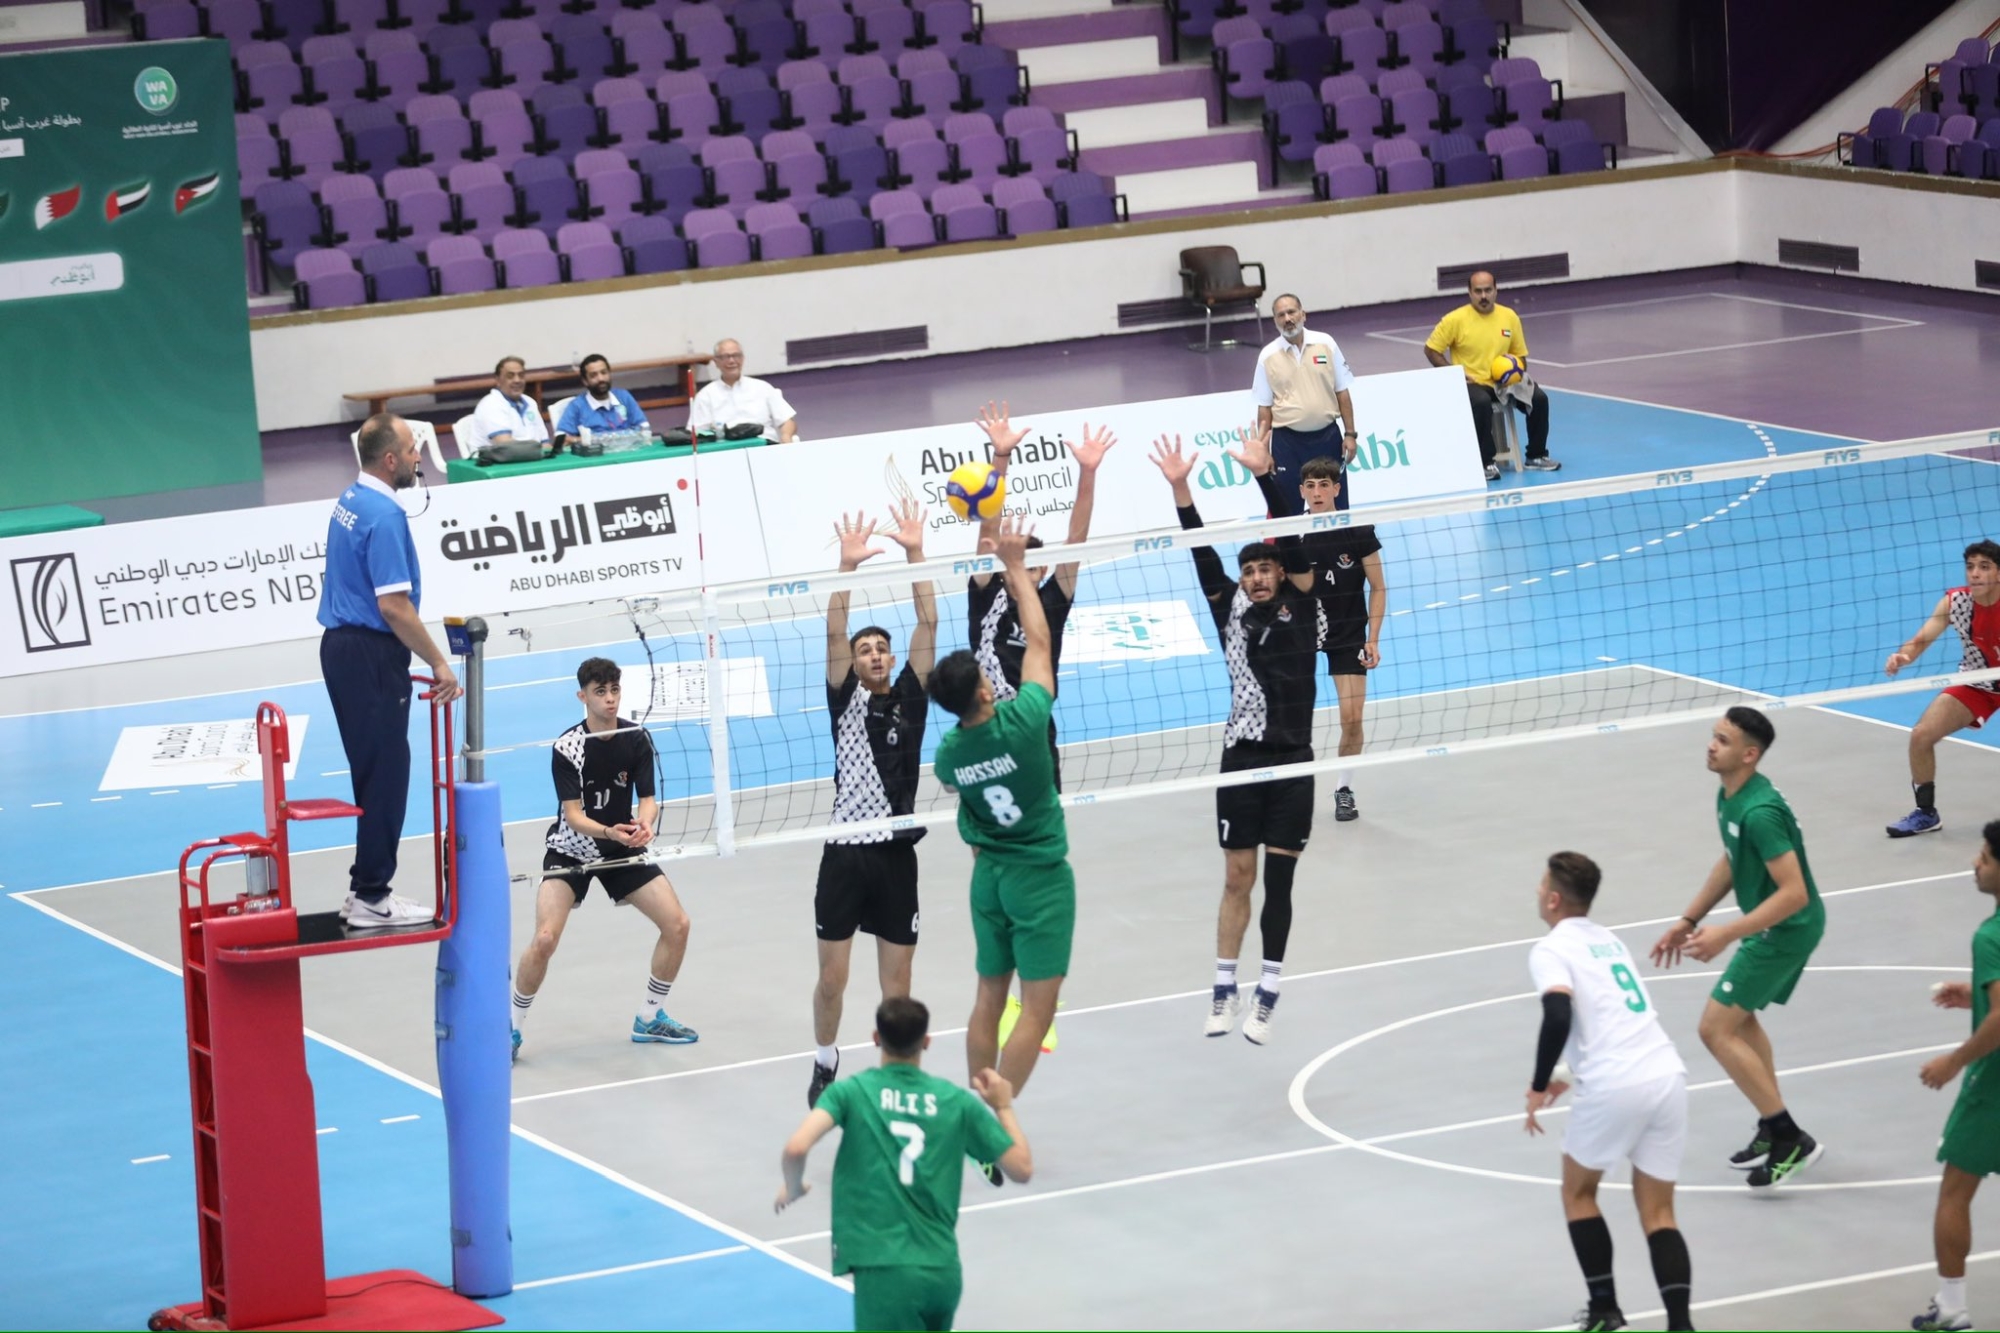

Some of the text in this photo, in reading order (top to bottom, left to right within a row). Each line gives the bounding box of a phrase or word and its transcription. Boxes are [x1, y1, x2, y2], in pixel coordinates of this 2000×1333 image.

[145, 81, 168, 93] WA
[149, 94, 168, 106] VA
[1824, 448, 1861, 465] FIVB
[1005, 466, 1073, 496] ouncil
[1657, 470, 1693, 486] FIVB
[1486, 491, 1523, 508] FIVB
[1312, 513, 1350, 529] FIVB
[440, 496, 672, 571] أبوظبي الرياضية
[1134, 535, 1173, 552] FIVB
[223, 543, 296, 572] الإمارات
[953, 557, 994, 575] FIVB
[93, 558, 170, 590] الوطني
[174, 559, 218, 581] دبي
[510, 557, 683, 592] ABU DHABI SPORTS TV
[1325, 569, 1336, 586] 4
[768, 582, 810, 597] FIVB
[99, 586, 256, 626] Emirates
[887, 727, 898, 746] 6
[954, 753, 1017, 786] HASSAN
[983, 785, 1023, 827] 8
[1221, 820, 1230, 841] 7
[911, 912, 919, 933] 6
[1611, 963, 1646, 1013] 9
[881, 1088, 938, 1117] ALI S
[889, 1121, 925, 1186] 7
